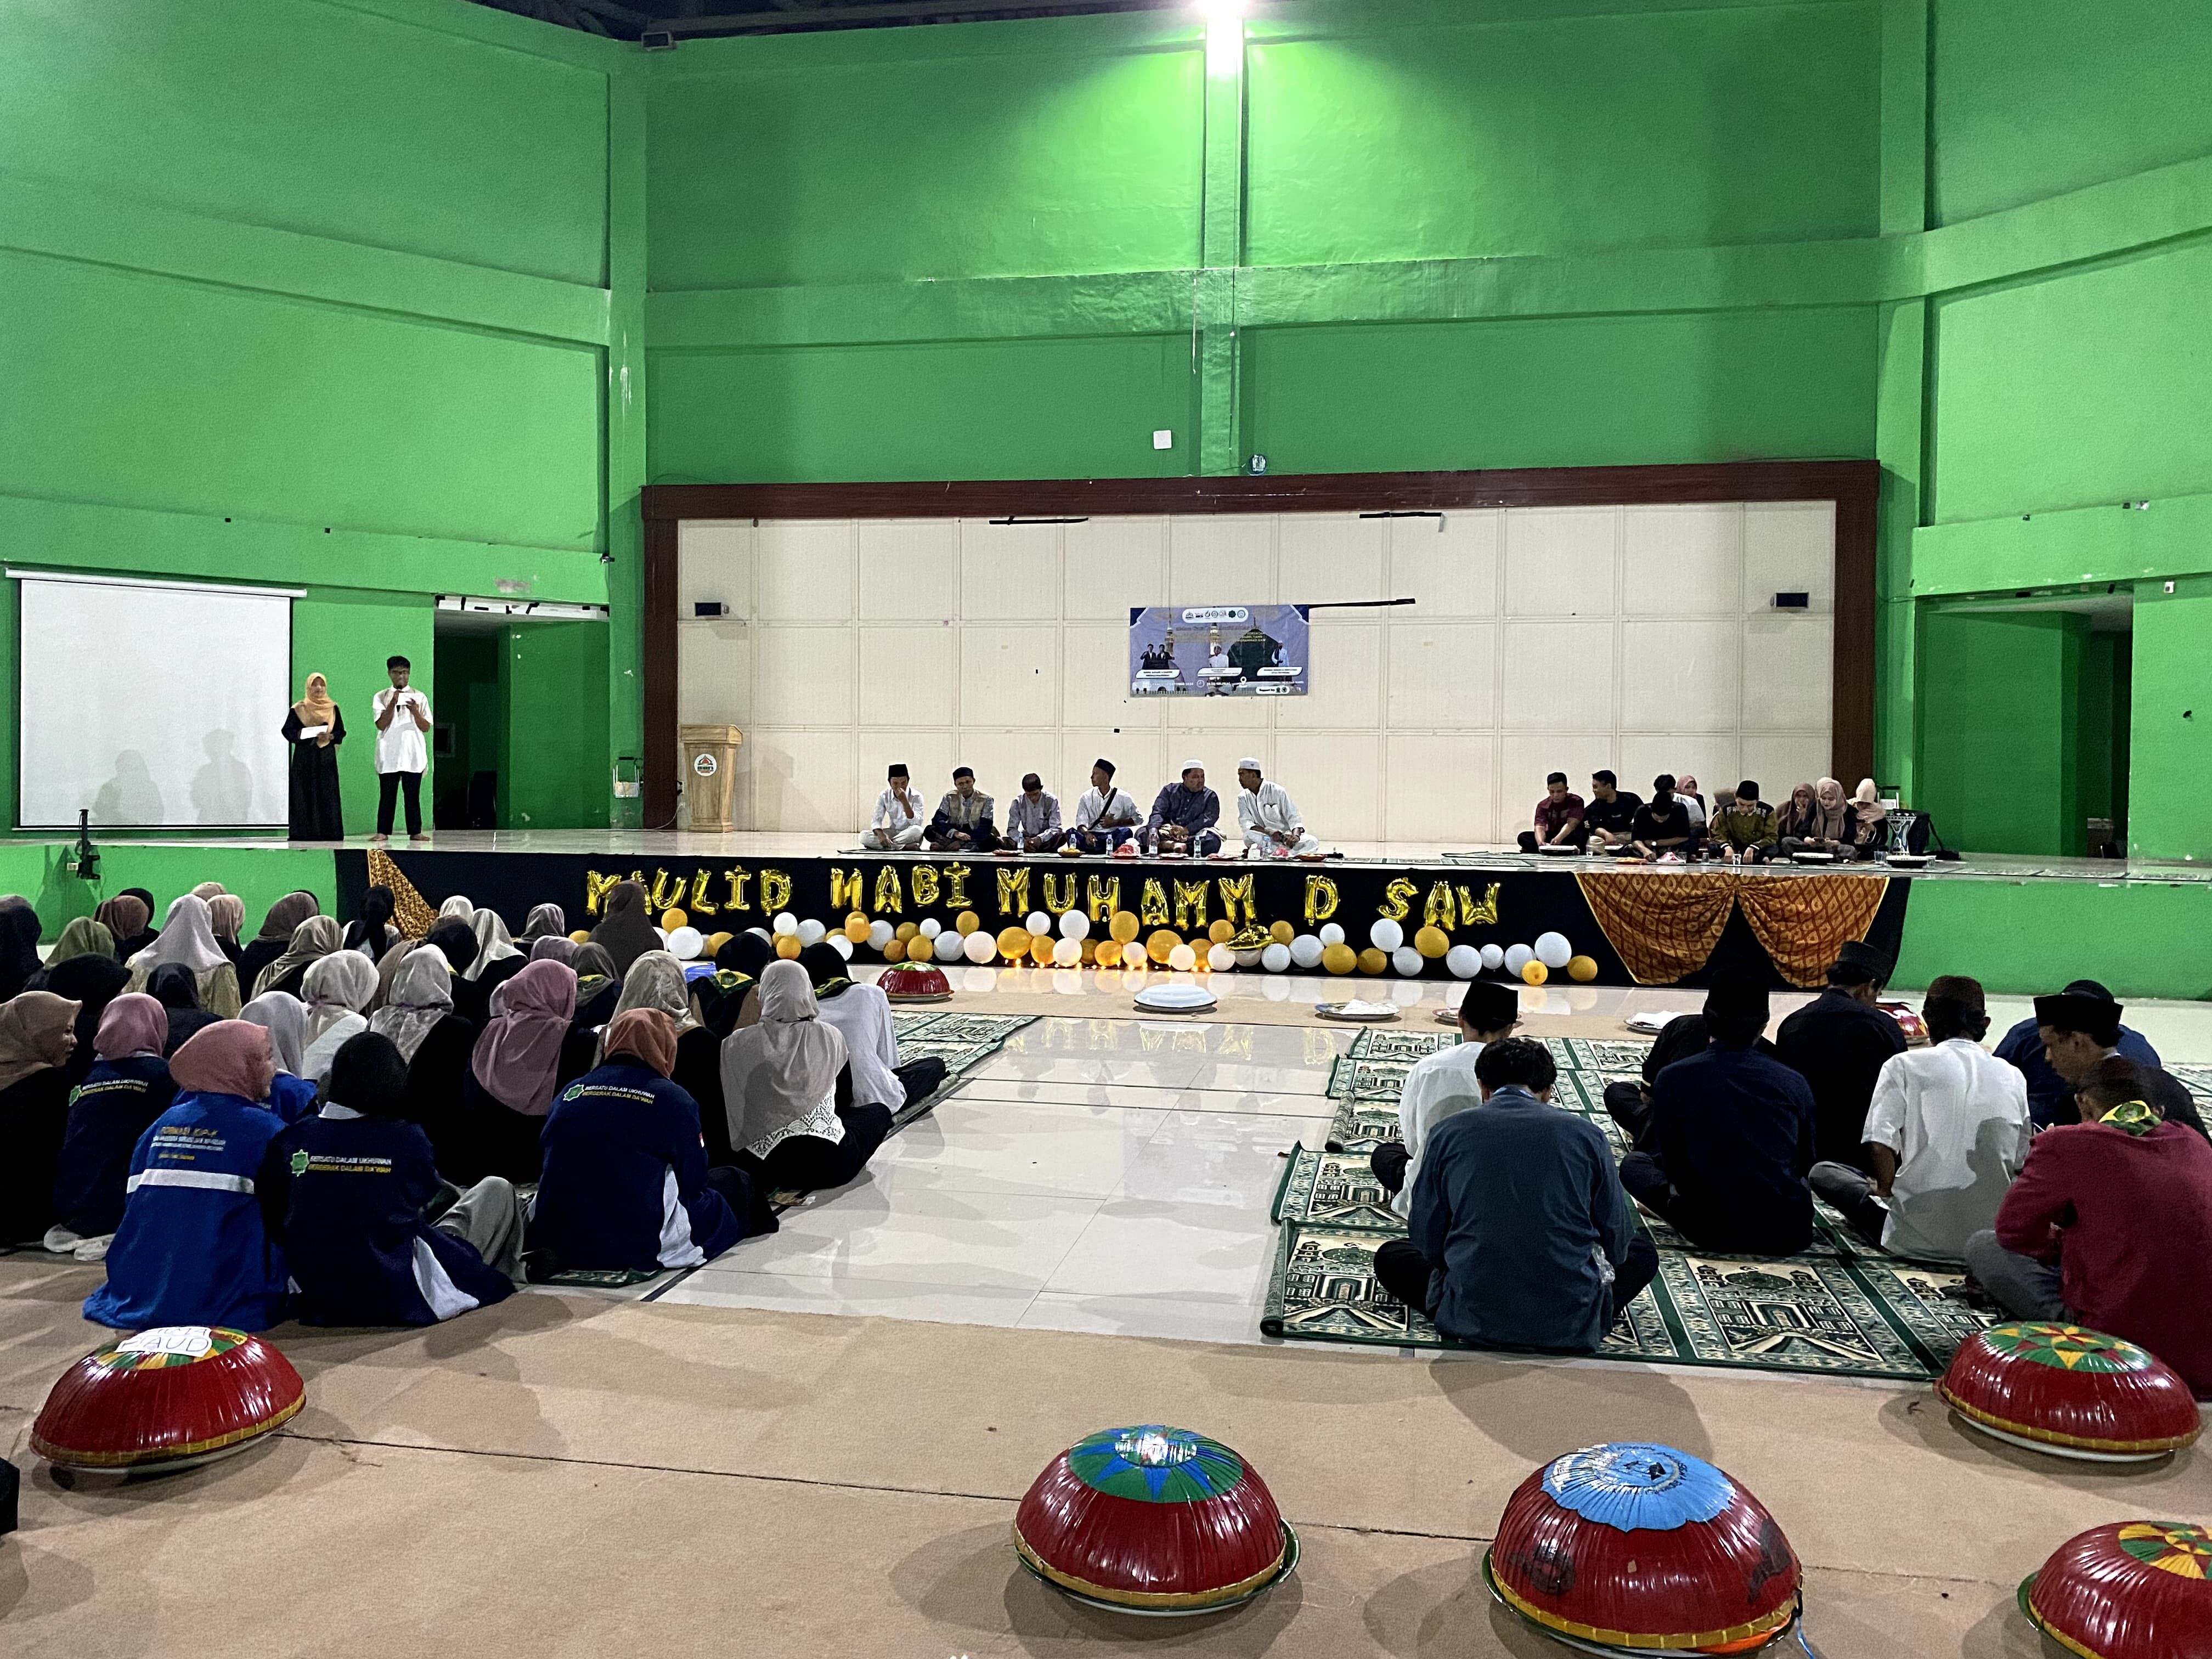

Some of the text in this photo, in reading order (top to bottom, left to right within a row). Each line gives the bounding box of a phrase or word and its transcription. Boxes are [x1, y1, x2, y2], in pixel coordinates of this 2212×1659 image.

[831, 861, 972, 913] NABI
[1376, 877, 1500, 931] SAW
[629, 1088, 654, 1098] UKHUWAH
